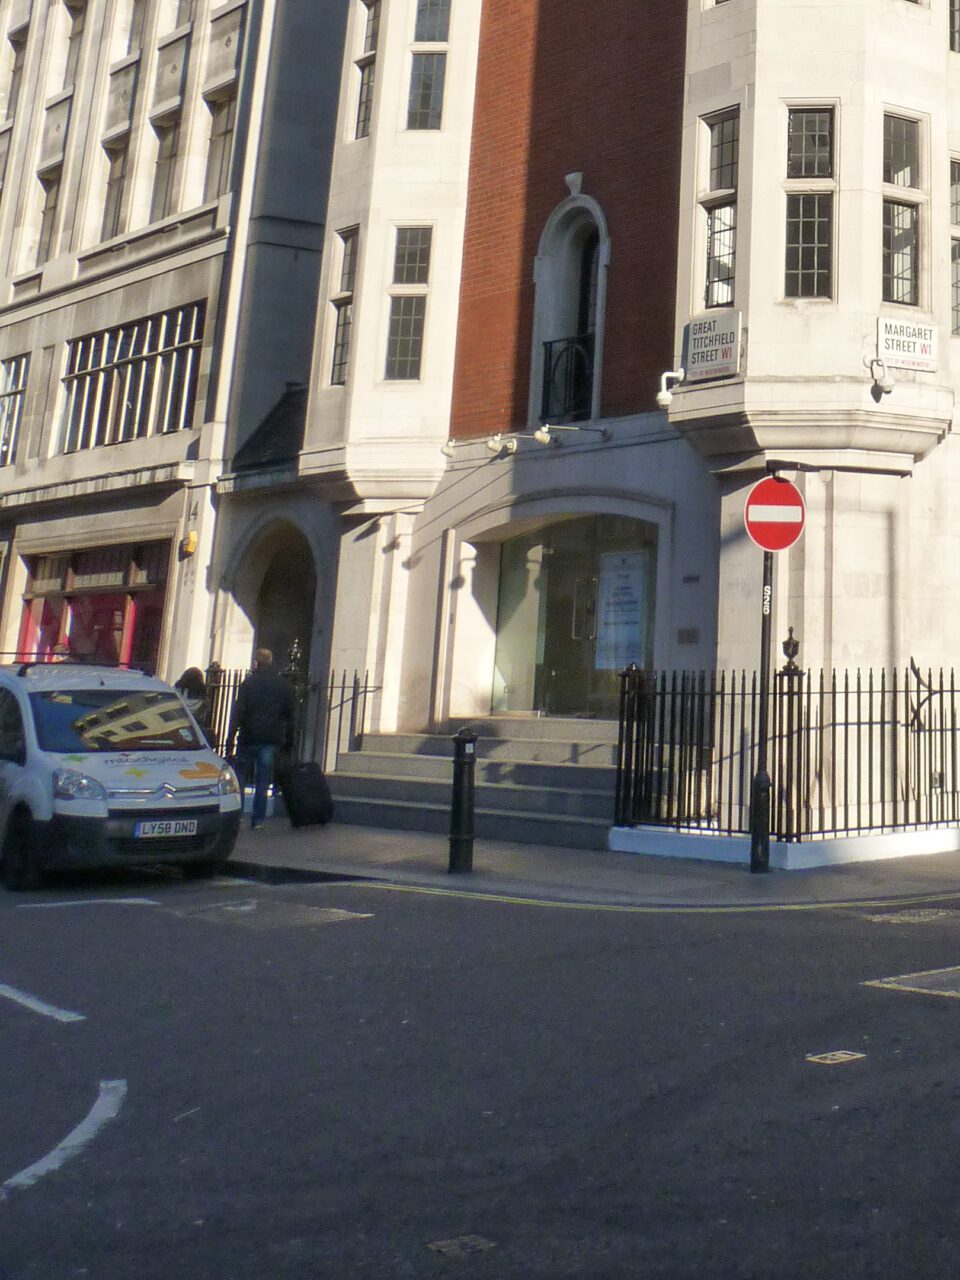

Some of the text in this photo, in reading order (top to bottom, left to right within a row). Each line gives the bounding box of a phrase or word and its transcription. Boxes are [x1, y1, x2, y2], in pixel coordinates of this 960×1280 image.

[692, 320, 717, 335] GREAT
[884, 323, 933, 341] MARGARET
[692, 331, 735, 349] TITCHFIELD
[884, 338, 932, 355] STREET W1
[691, 347, 732, 364] STREET W1
[188, 501, 199, 521] 14
